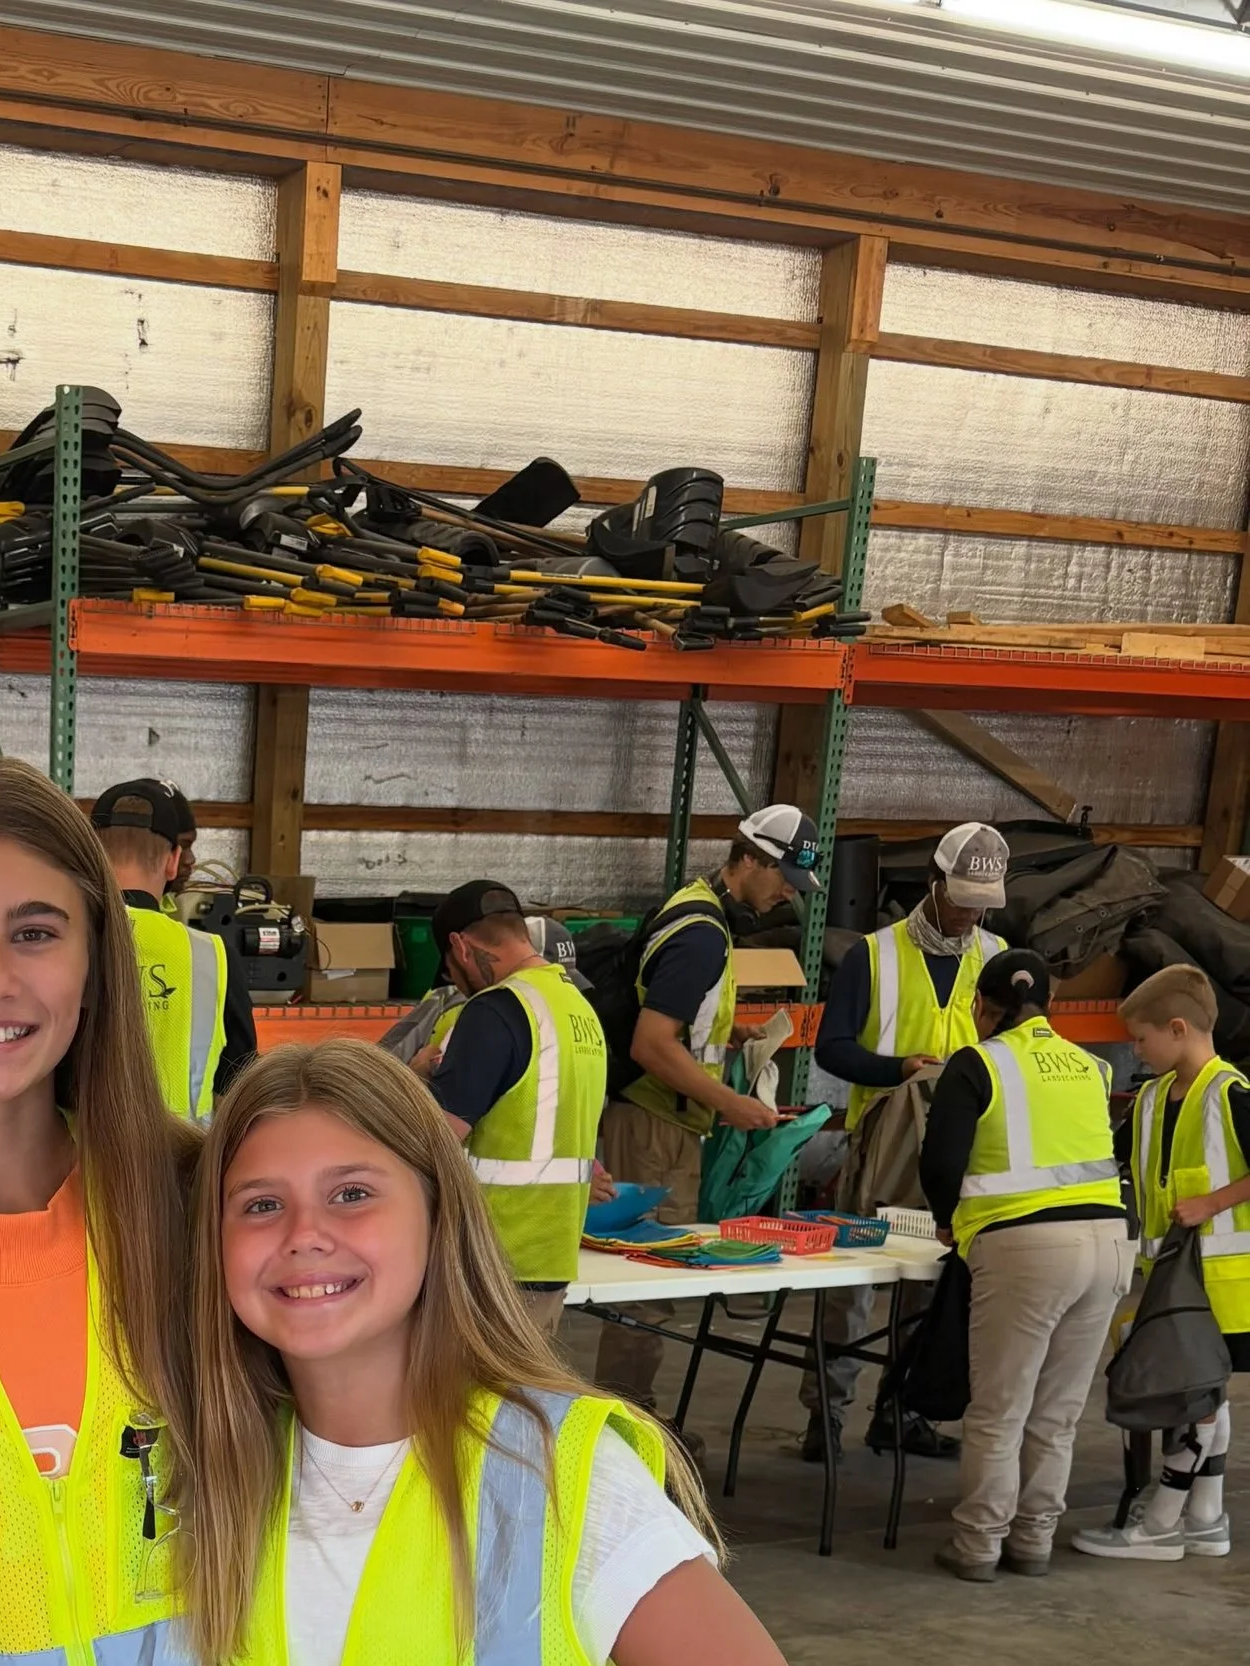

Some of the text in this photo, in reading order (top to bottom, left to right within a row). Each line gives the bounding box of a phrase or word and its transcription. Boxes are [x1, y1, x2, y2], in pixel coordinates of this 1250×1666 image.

[970, 856, 1002, 871] BWS
[569, 1014, 601, 1047] BWS
[1030, 1052, 1085, 1074] BWS
